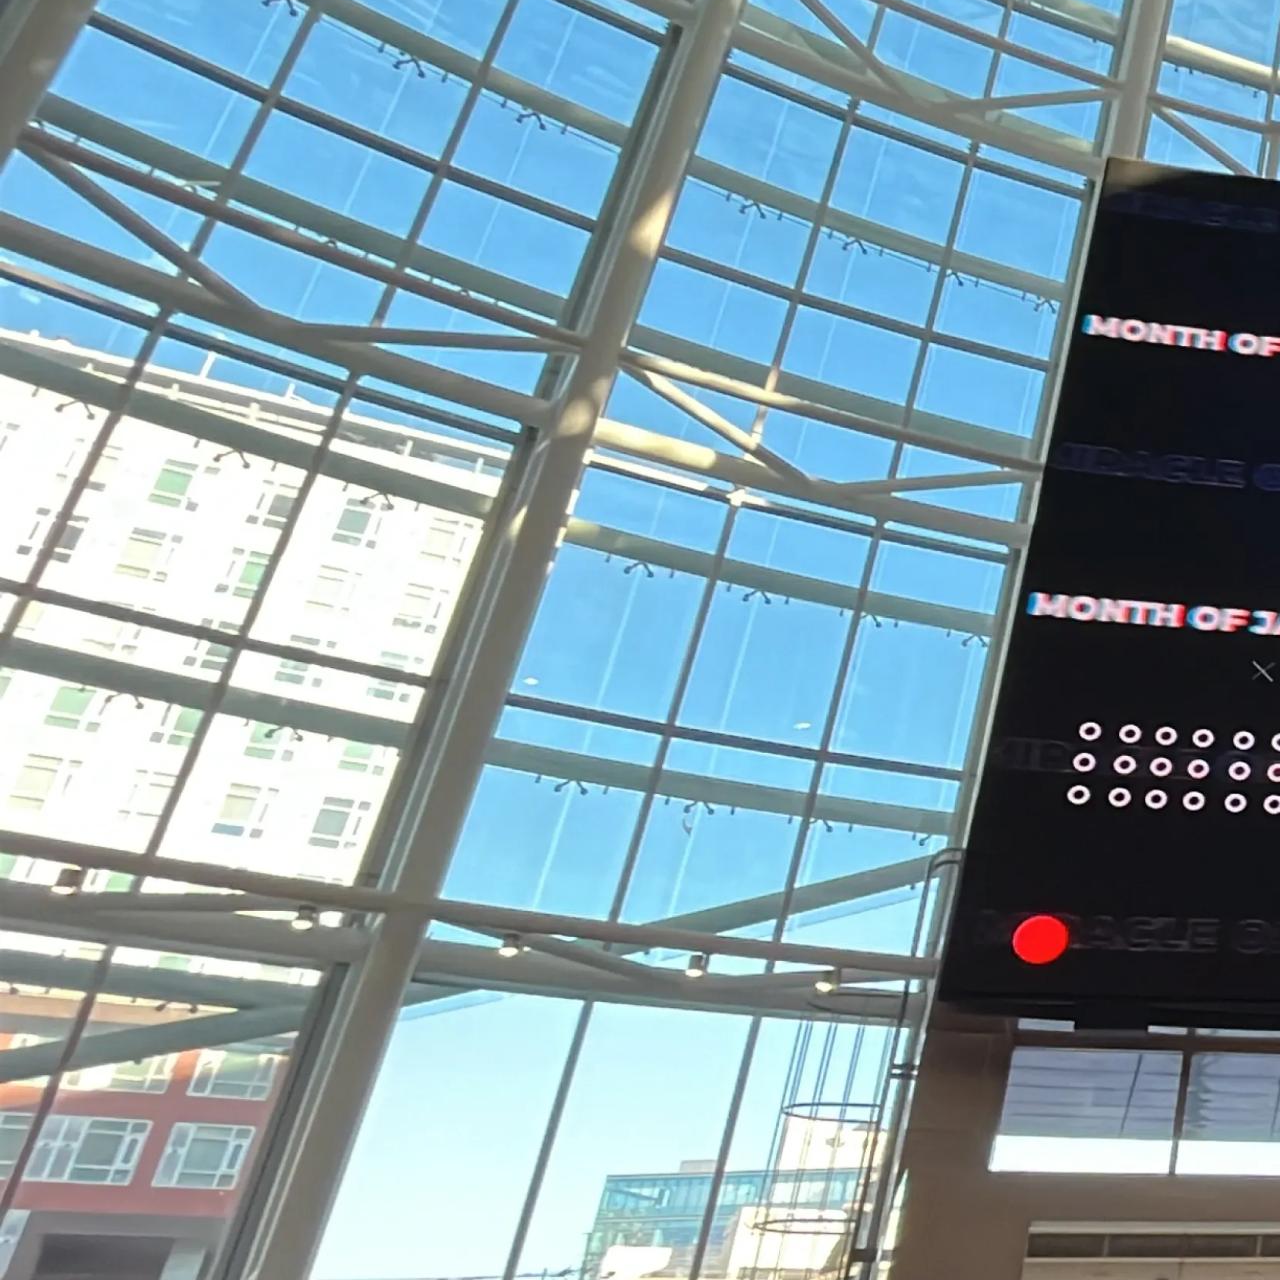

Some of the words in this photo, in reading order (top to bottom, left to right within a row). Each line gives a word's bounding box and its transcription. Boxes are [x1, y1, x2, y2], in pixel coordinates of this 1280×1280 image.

[1082, 313, 1229, 352] MONTH
[1027, 590, 1188, 629] MONTH
[1187, 603, 1253, 633] OF
